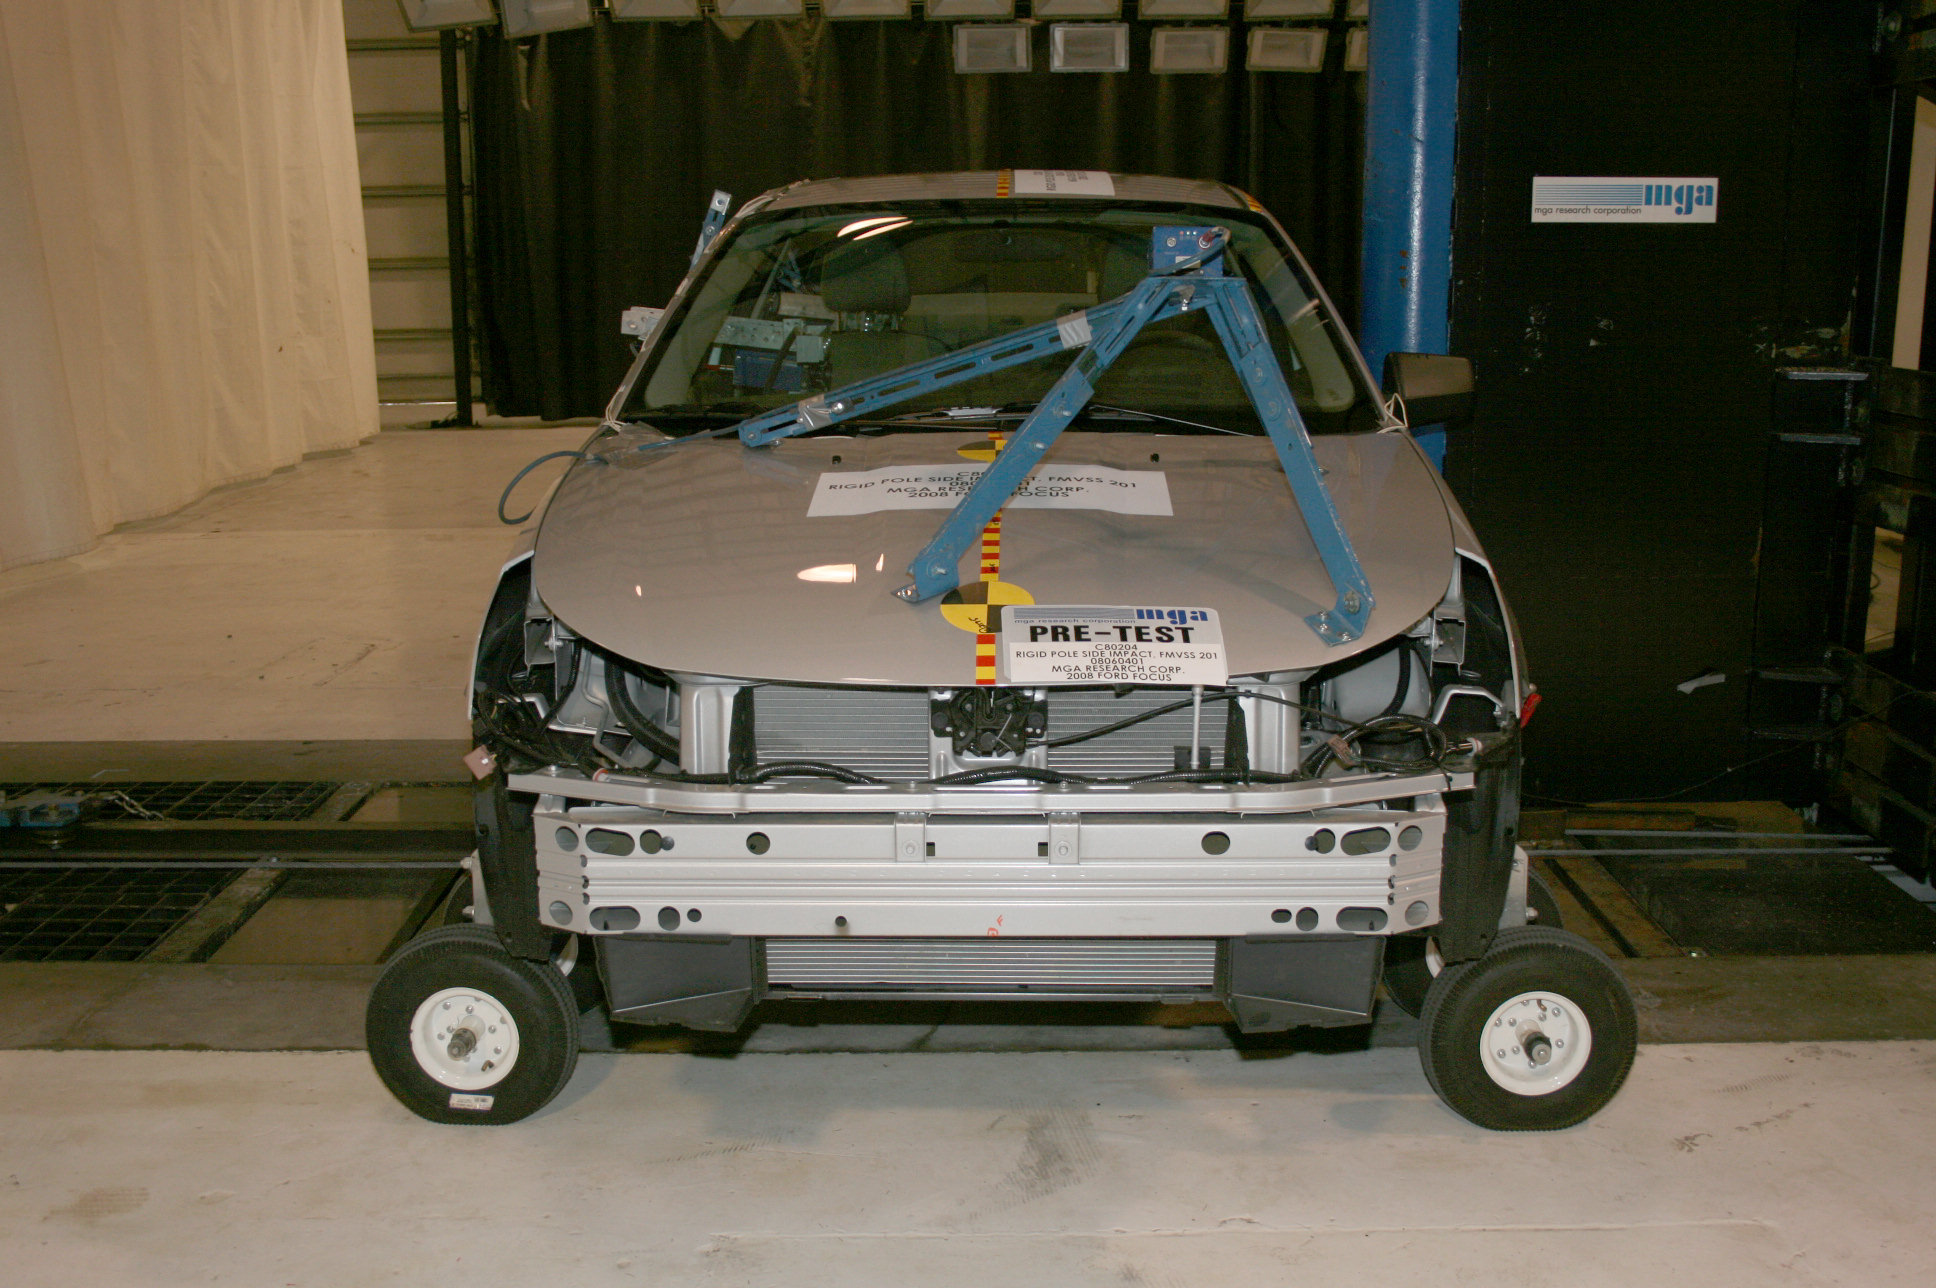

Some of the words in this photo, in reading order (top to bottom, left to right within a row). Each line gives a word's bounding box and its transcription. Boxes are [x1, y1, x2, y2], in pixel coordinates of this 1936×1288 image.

[1644, 184, 1714, 216] mga
[1534, 207, 1553, 215] mga
[1556, 206, 1591, 214] research
[1593, 206, 1642, 216] corporation
[829, 482, 875, 490] RIGID
[881, 476, 923, 485] POLE
[1110, 480, 1137, 488] 201
[1136, 608, 1209, 625] mga
[1029, 625, 1194, 644] PRE-TEST
[1095, 643, 1138, 651] C80204
[1016, 650, 1047, 658] RIGID
[1051, 650, 1079, 658] POLE
[1082, 650, 1106, 658] SIDE
[1159, 651, 1196, 659] FMVSS
[1199, 652, 1217, 660] 201
[1090, 657, 1143, 665] 08060401
[1086, 664, 1145, 673] RESEARCH
[1148, 665, 1185, 674] CORP.
[1066, 672, 1094, 680] 2008
[1098, 672, 1129, 680] FORD
[1133, 672, 1172, 681] FOCUS
